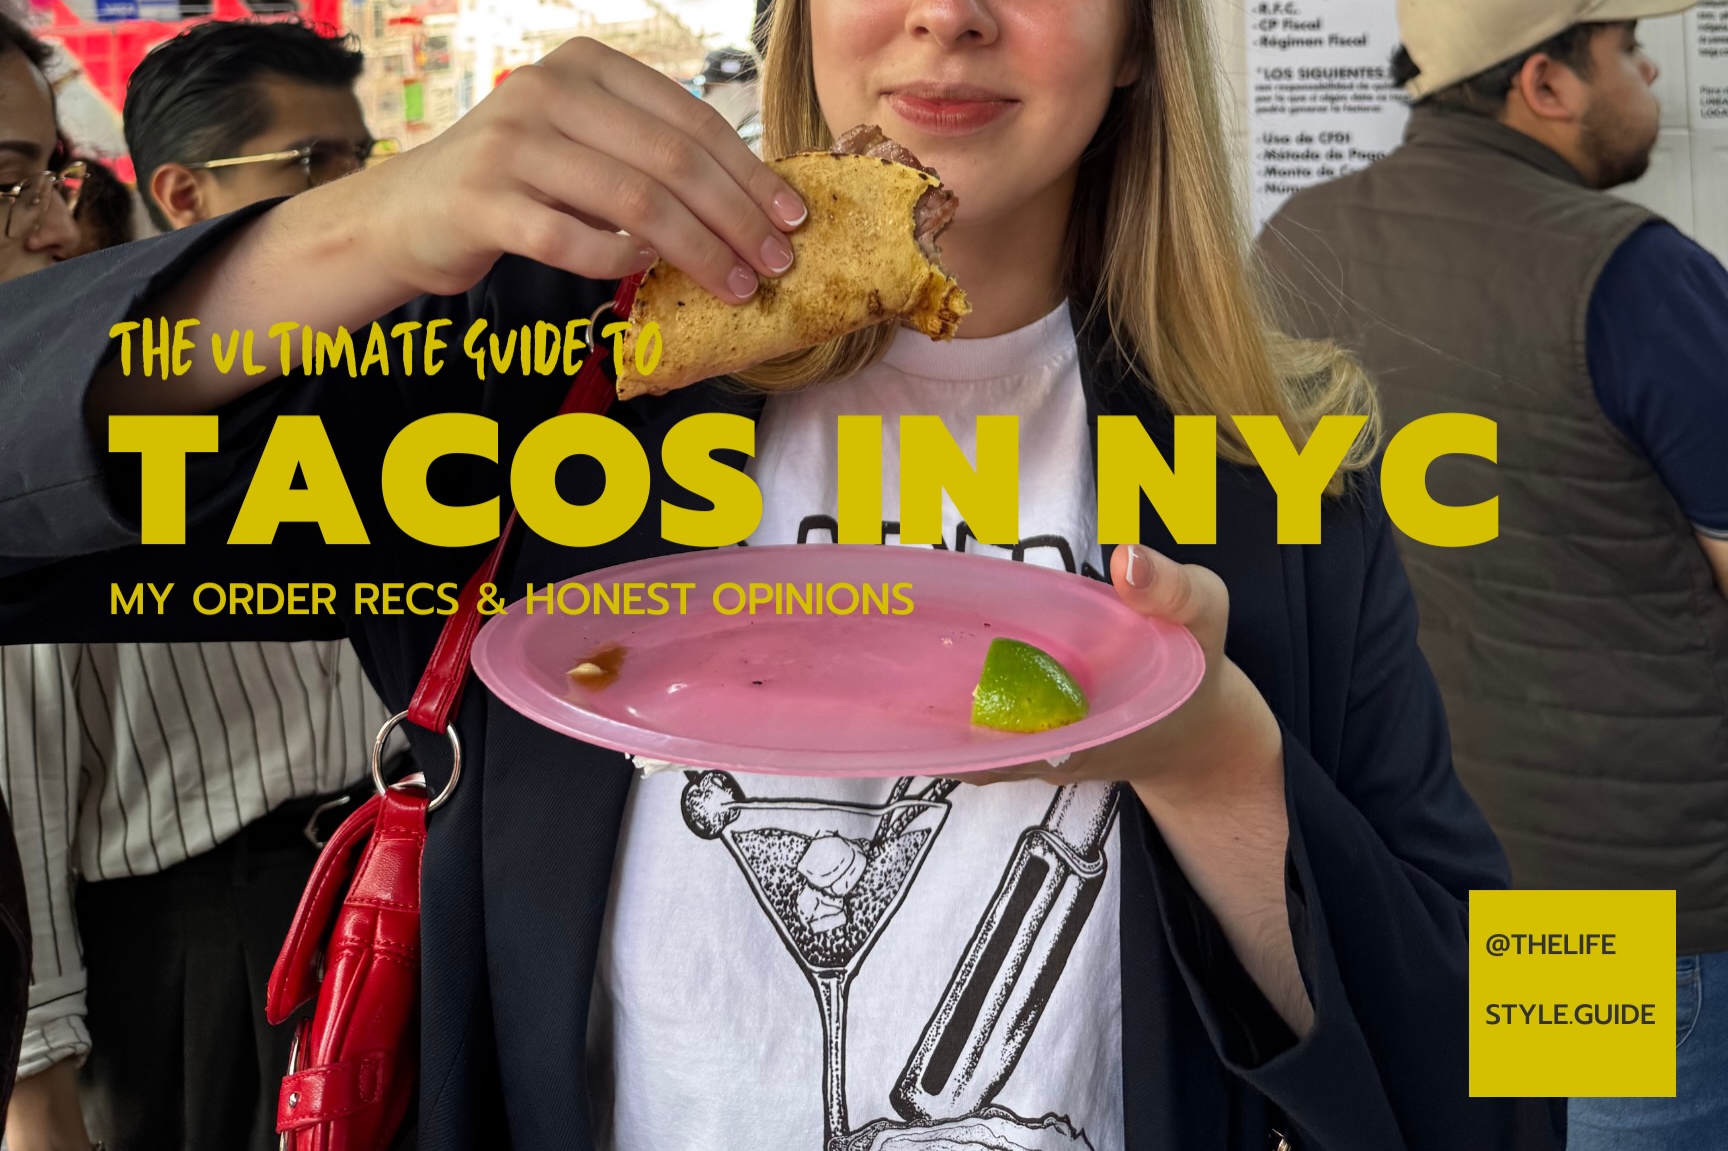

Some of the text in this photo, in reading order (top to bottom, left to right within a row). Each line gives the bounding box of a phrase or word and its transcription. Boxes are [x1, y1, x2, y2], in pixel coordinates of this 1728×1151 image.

[1258, 17, 1321, 31] CP Fiscal
[1328, 33, 1367, 46] Fiscal
